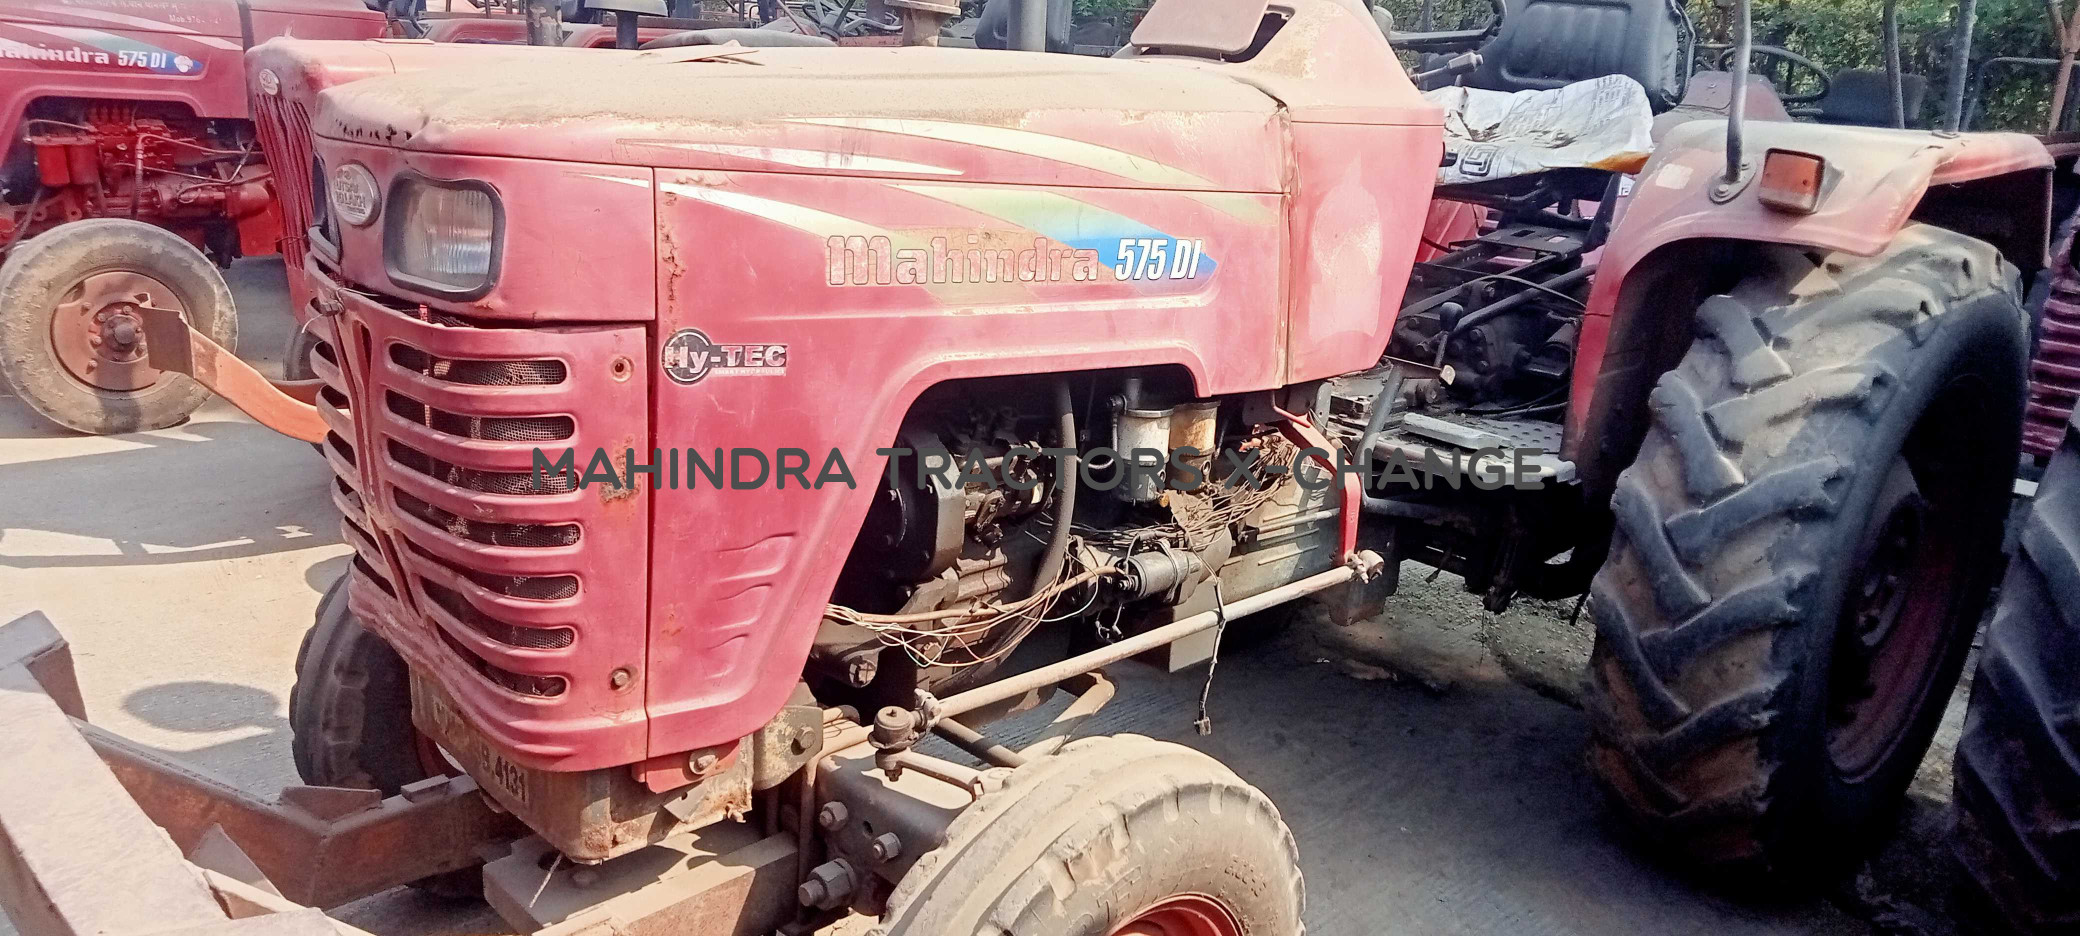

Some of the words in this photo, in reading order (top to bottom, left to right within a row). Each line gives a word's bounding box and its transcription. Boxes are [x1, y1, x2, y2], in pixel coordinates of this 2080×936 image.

[0, 43, 109, 64] ahindra
[117, 50, 147, 68] 575
[150, 52, 167, 69] DI
[826, 234, 1099, 285] Mahindra
[1114, 238, 1168, 282] 575
[1168, 239, 1204, 281] DI
[663, 345, 786, 374] Hy-TEC
